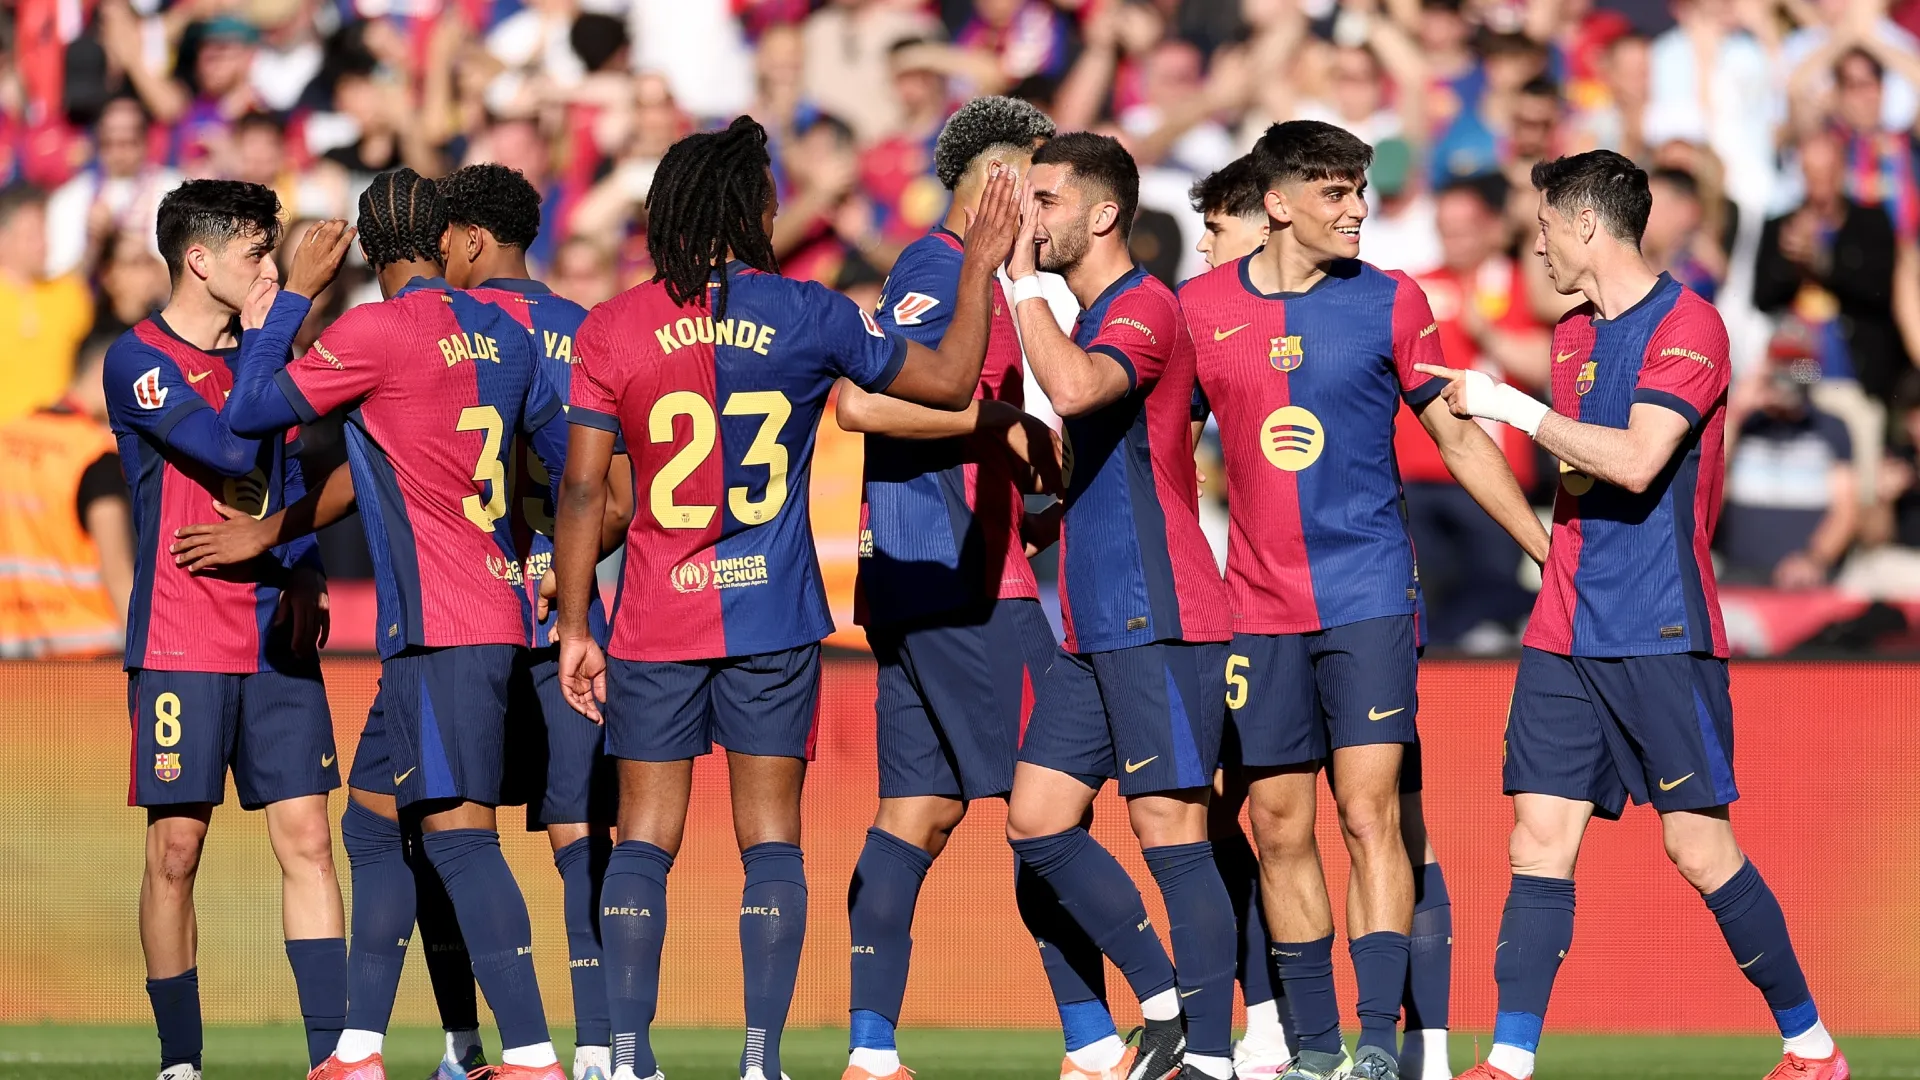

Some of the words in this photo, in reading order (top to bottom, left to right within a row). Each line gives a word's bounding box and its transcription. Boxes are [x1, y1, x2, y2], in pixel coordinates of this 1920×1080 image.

[437, 332, 501, 368] BALDE
[654, 316, 776, 356] KOUNDE
[1660, 347, 1708, 365] AMBILIGHT
[455, 405, 507, 533] 3
[648, 390, 793, 529] 23
[710, 555, 767, 572] UNHCR
[712, 567, 768, 585] ACNUR
[155, 692, 182, 747] 8
[604, 906, 651, 917] BARÇA
